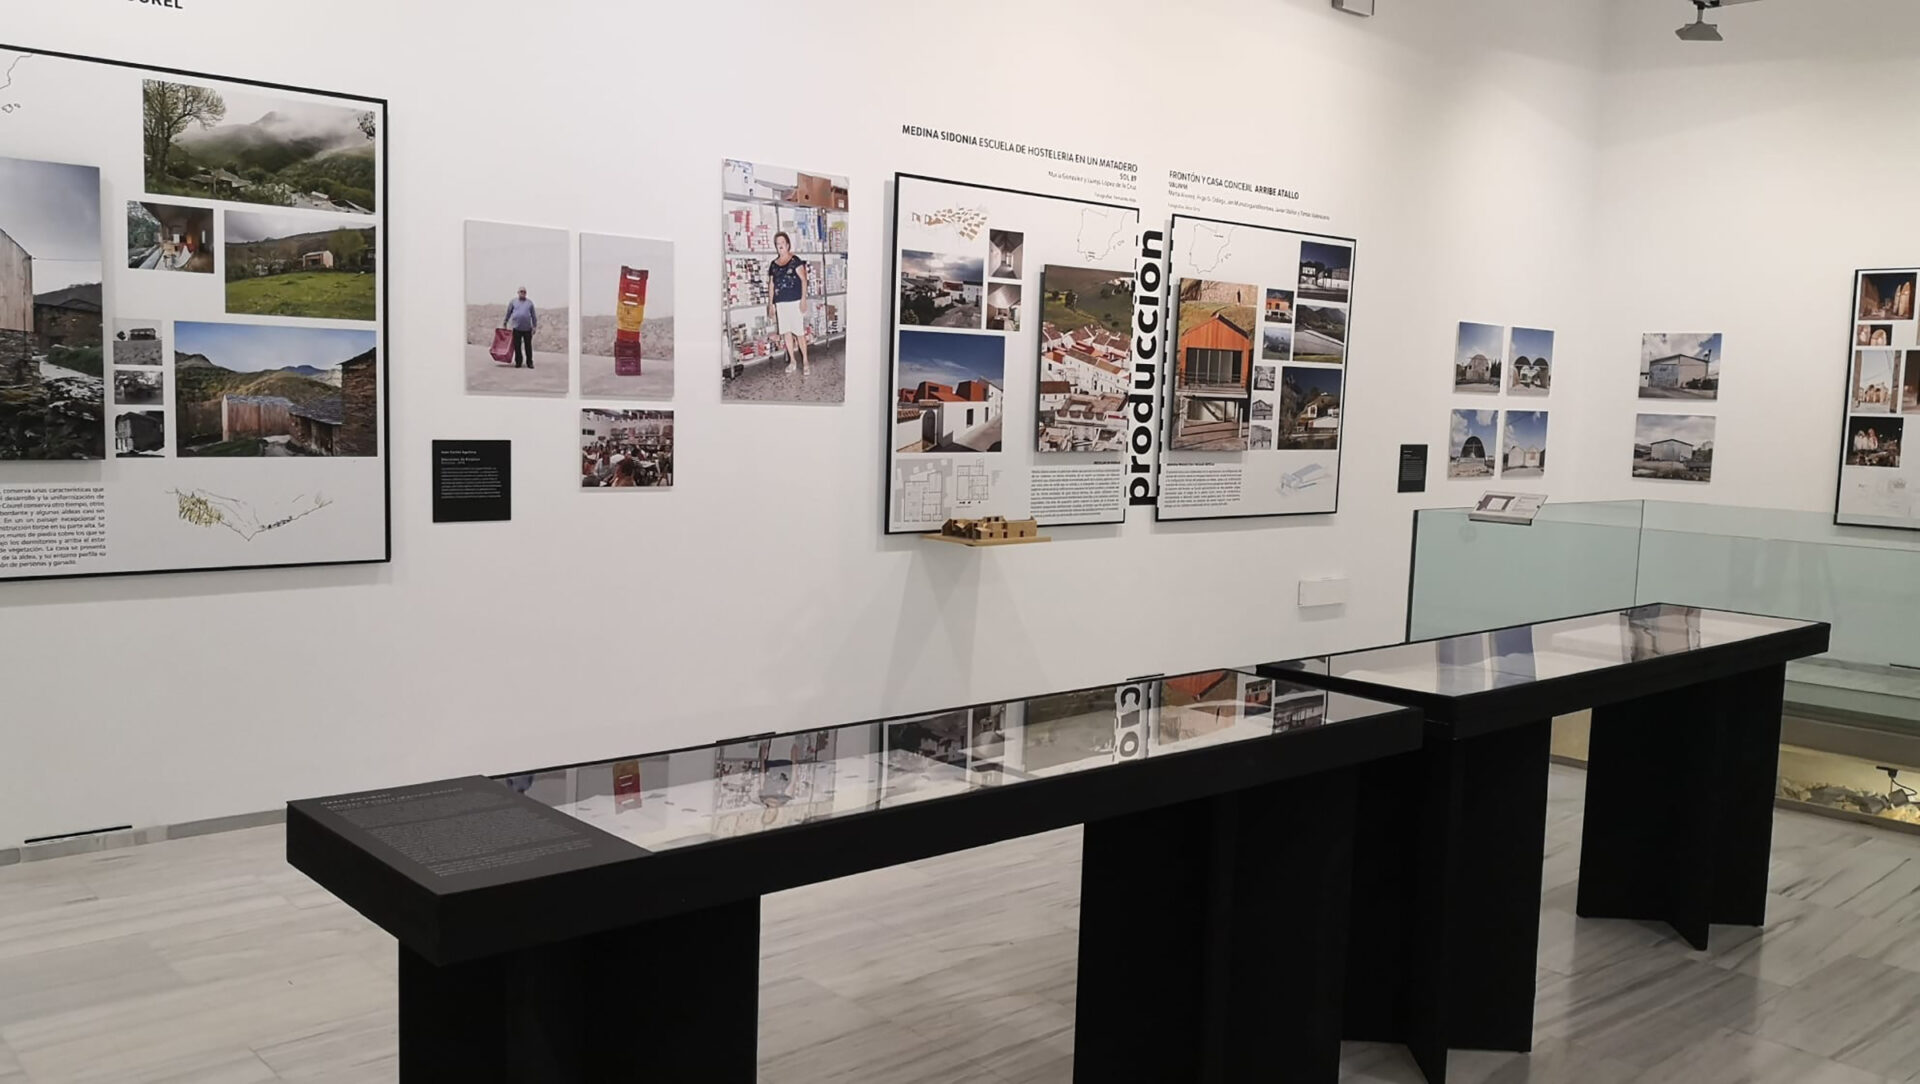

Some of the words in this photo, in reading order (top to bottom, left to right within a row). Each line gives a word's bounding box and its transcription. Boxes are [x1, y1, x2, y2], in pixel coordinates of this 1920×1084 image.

[902, 124, 939, 140] MEDINA
[940, 131, 977, 146] SIDONIA
[978, 138, 1014, 152] ESCUELA
[1016, 144, 1026, 154] DE
[1075, 154, 1086, 164] EN
[1087, 157, 1098, 166] UN
[1099, 158, 1138, 173] MATADERO
[1202, 175, 1206, 184] Y
[1206, 176, 1223, 187] CASA
[1254, 185, 1276, 196] ARRIBE
[1277, 187, 1300, 200] ATALLO
